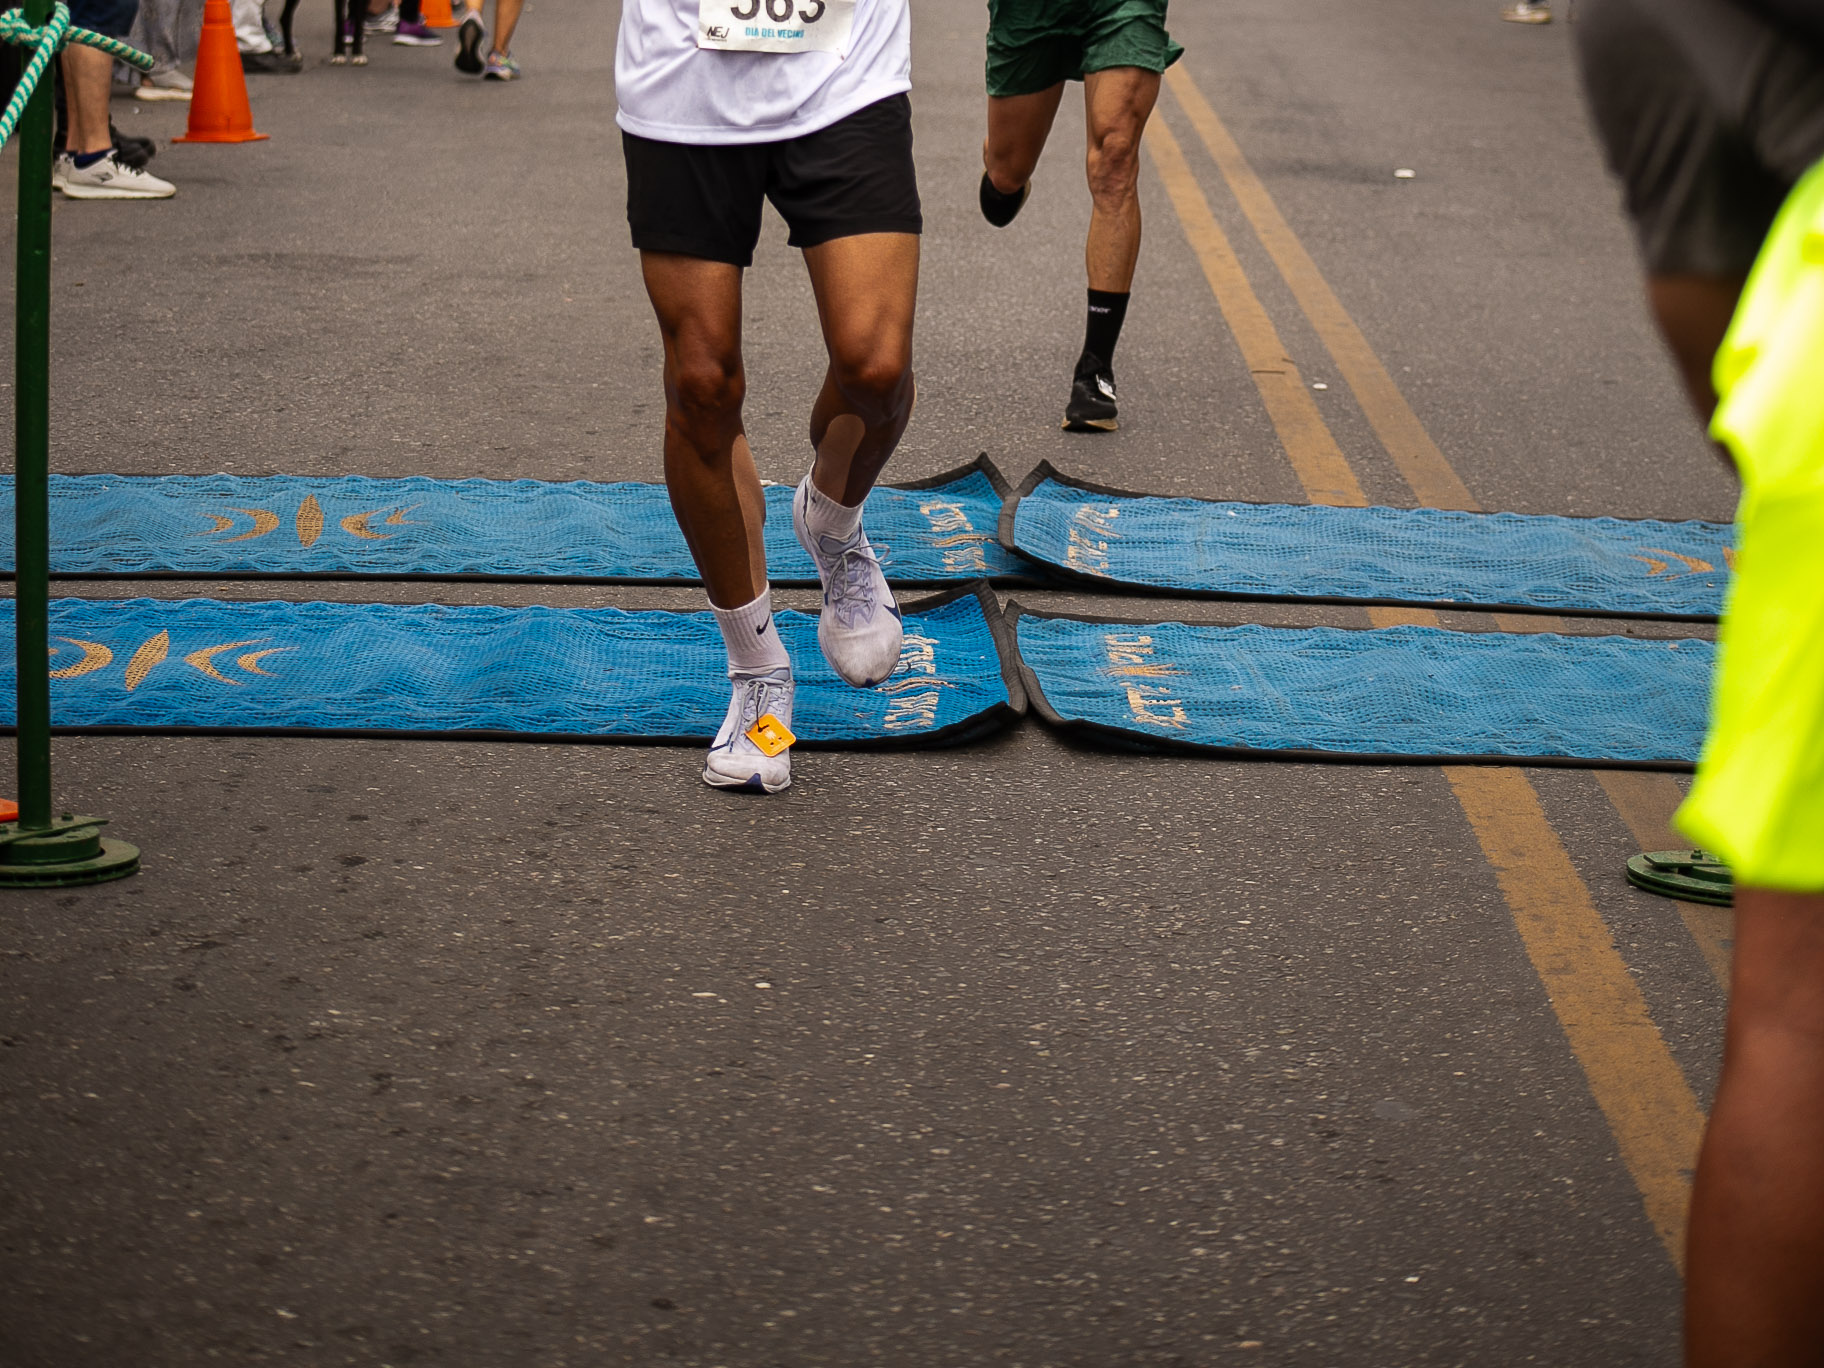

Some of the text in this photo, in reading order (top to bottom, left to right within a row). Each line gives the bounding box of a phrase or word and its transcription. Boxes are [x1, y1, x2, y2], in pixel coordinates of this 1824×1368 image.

[706, 26, 729, 39] NEJ
[745, 27, 759, 36] DIA
[761, 28, 775, 38] DEL
